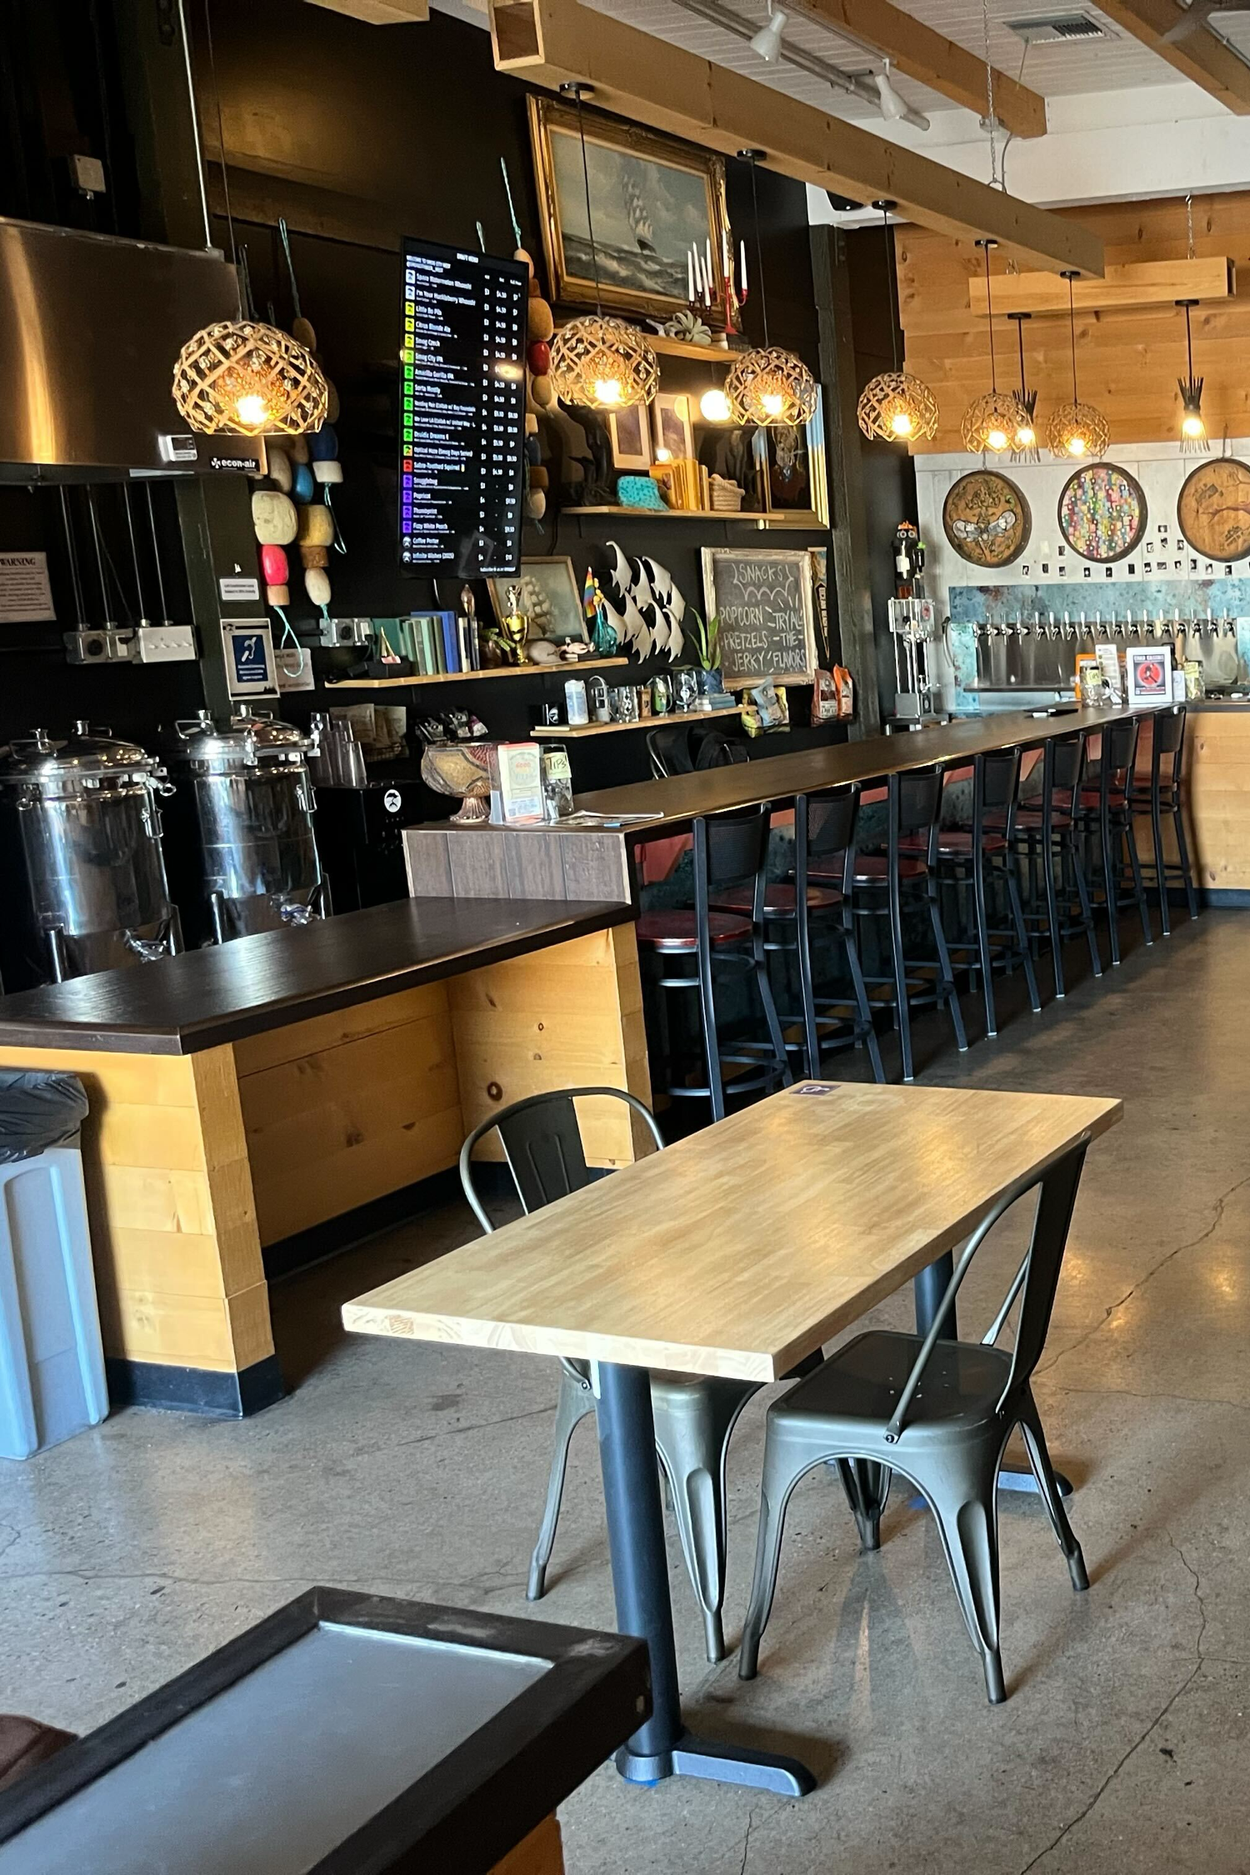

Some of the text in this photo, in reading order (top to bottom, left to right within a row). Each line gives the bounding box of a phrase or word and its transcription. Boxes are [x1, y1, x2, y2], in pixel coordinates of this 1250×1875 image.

[221, 459, 256, 468] econ-air
[739, 564, 783, 583] SNACKS
[720, 606, 763, 626] POPCORN
[724, 631, 768, 650] PRETZELS
[782, 632, 798, 647] THE
[733, 651, 764, 671] JERKY
[773, 650, 806, 668] FLAVORS
